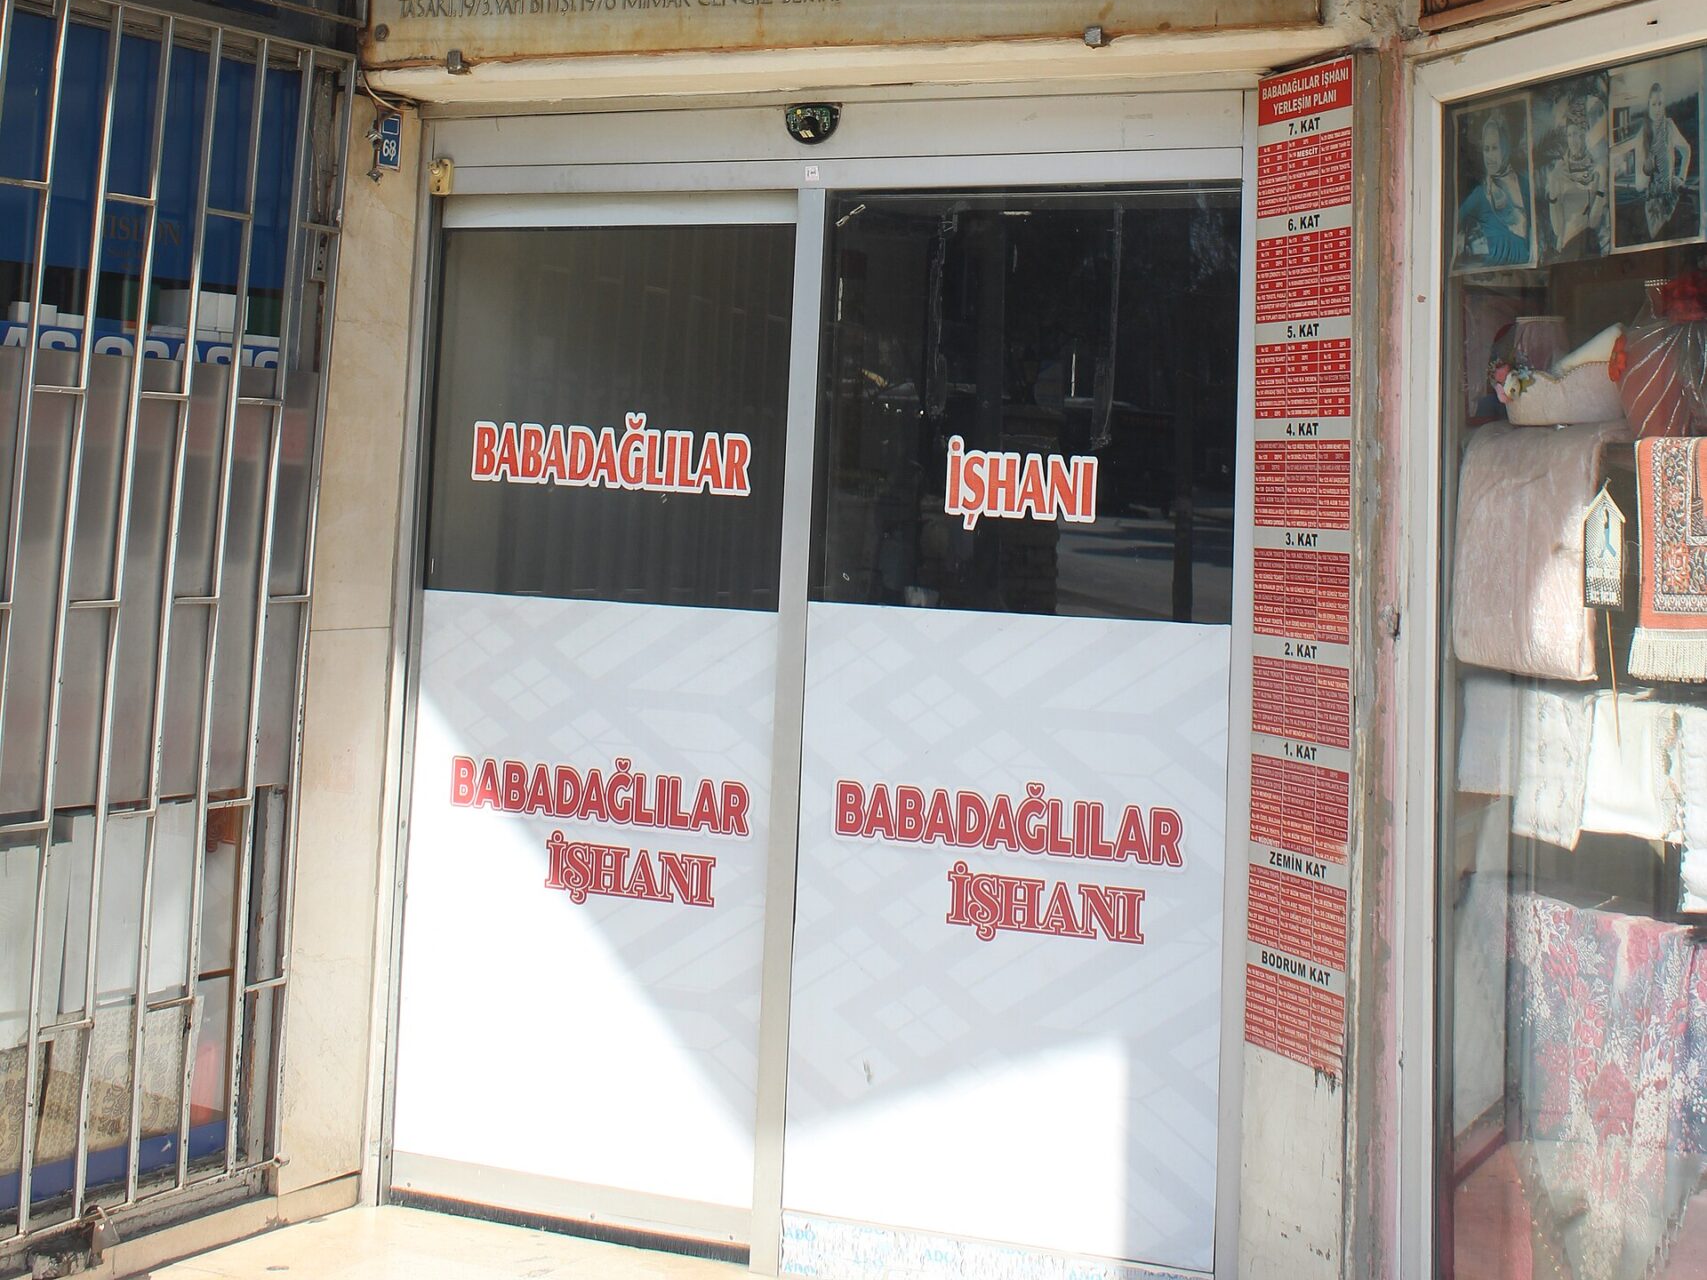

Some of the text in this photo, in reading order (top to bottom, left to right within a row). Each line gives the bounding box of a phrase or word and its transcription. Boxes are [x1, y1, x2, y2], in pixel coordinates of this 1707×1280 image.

[1262, 67, 1349, 100] BABADAĞLILAR İŞHANI
[1273, 89, 1337, 116] YERLEŞİM PLANI
[1289, 117, 1321, 136] 7. KAT
[1297, 147, 1319, 159] MESCİT
[1288, 214, 1320, 231] 6. KAT
[1287, 323, 1320, 338] 5. KAT
[1286, 423, 1319, 436] 4. KAT
[471, 413, 752, 497] BABADAĞLILAR
[945, 435, 1098, 530] İŞHANI
[1285, 532, 1318, 547] 3. KAT
[1284, 642, 1317, 659] 2. KAT
[1284, 743, 1317, 761] 1. KAT
[451, 757, 750, 838] BABADAĞLILAR
[834, 781, 1184, 868] BABADAĞLILAR
[545, 830, 716, 907] İŞHANI
[1269, 851, 1327, 880] ZEMİN KAT
[946, 861, 1146, 945] İŞHANI
[1261, 950, 1331, 987] BODRUM KAT
